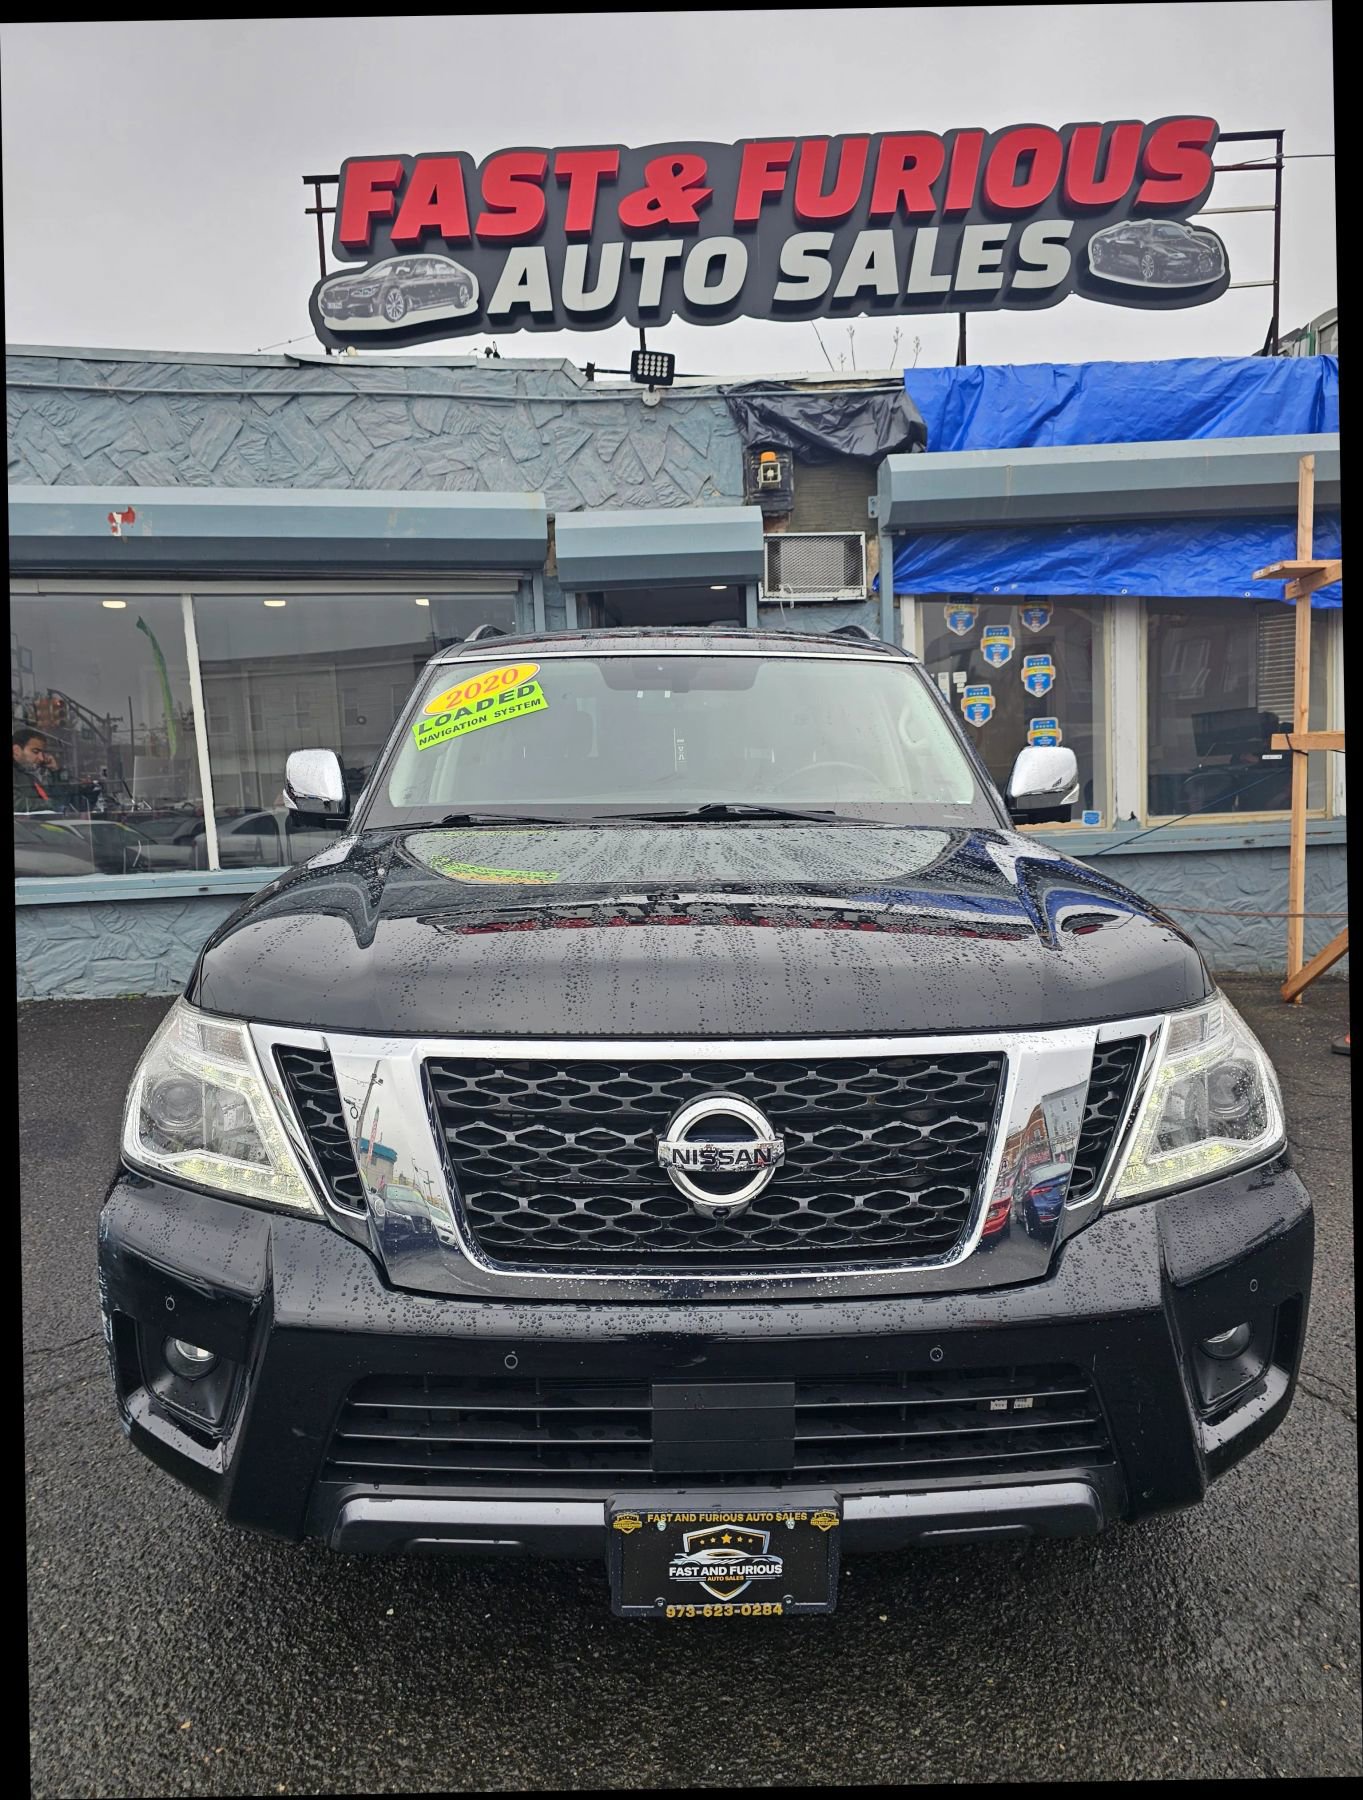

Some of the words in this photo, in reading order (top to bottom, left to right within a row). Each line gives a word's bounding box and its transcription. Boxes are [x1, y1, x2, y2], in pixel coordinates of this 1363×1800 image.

[340, 150, 620, 247] FAST
[618, 153, 713, 228] &
[734, 118, 1217, 227] FURIOUS
[487, 236, 748, 314] AUTO
[773, 219, 1075, 302] SALES
[445, 668, 519, 709] 2020
[418, 684, 536, 735] LOADED
[419, 715, 488, 746] NAVIGATION
[494, 698, 541, 718] SYSTEM
[672, 1147, 772, 1166] NISSAN
[647, 1513, 673, 1523] FAST
[674, 1513, 697, 1523] AND
[699, 1513, 744, 1522] FURIOUS
[745, 1512, 774, 1522] AUTO
[775, 1512, 808, 1521] SALES
[669, 1566, 700, 1577] FAST
[701, 1566, 728, 1577] AND
[729, 1564, 783, 1576] FURIOUS
[666, 1603, 783, 1617] 973-623-0284
